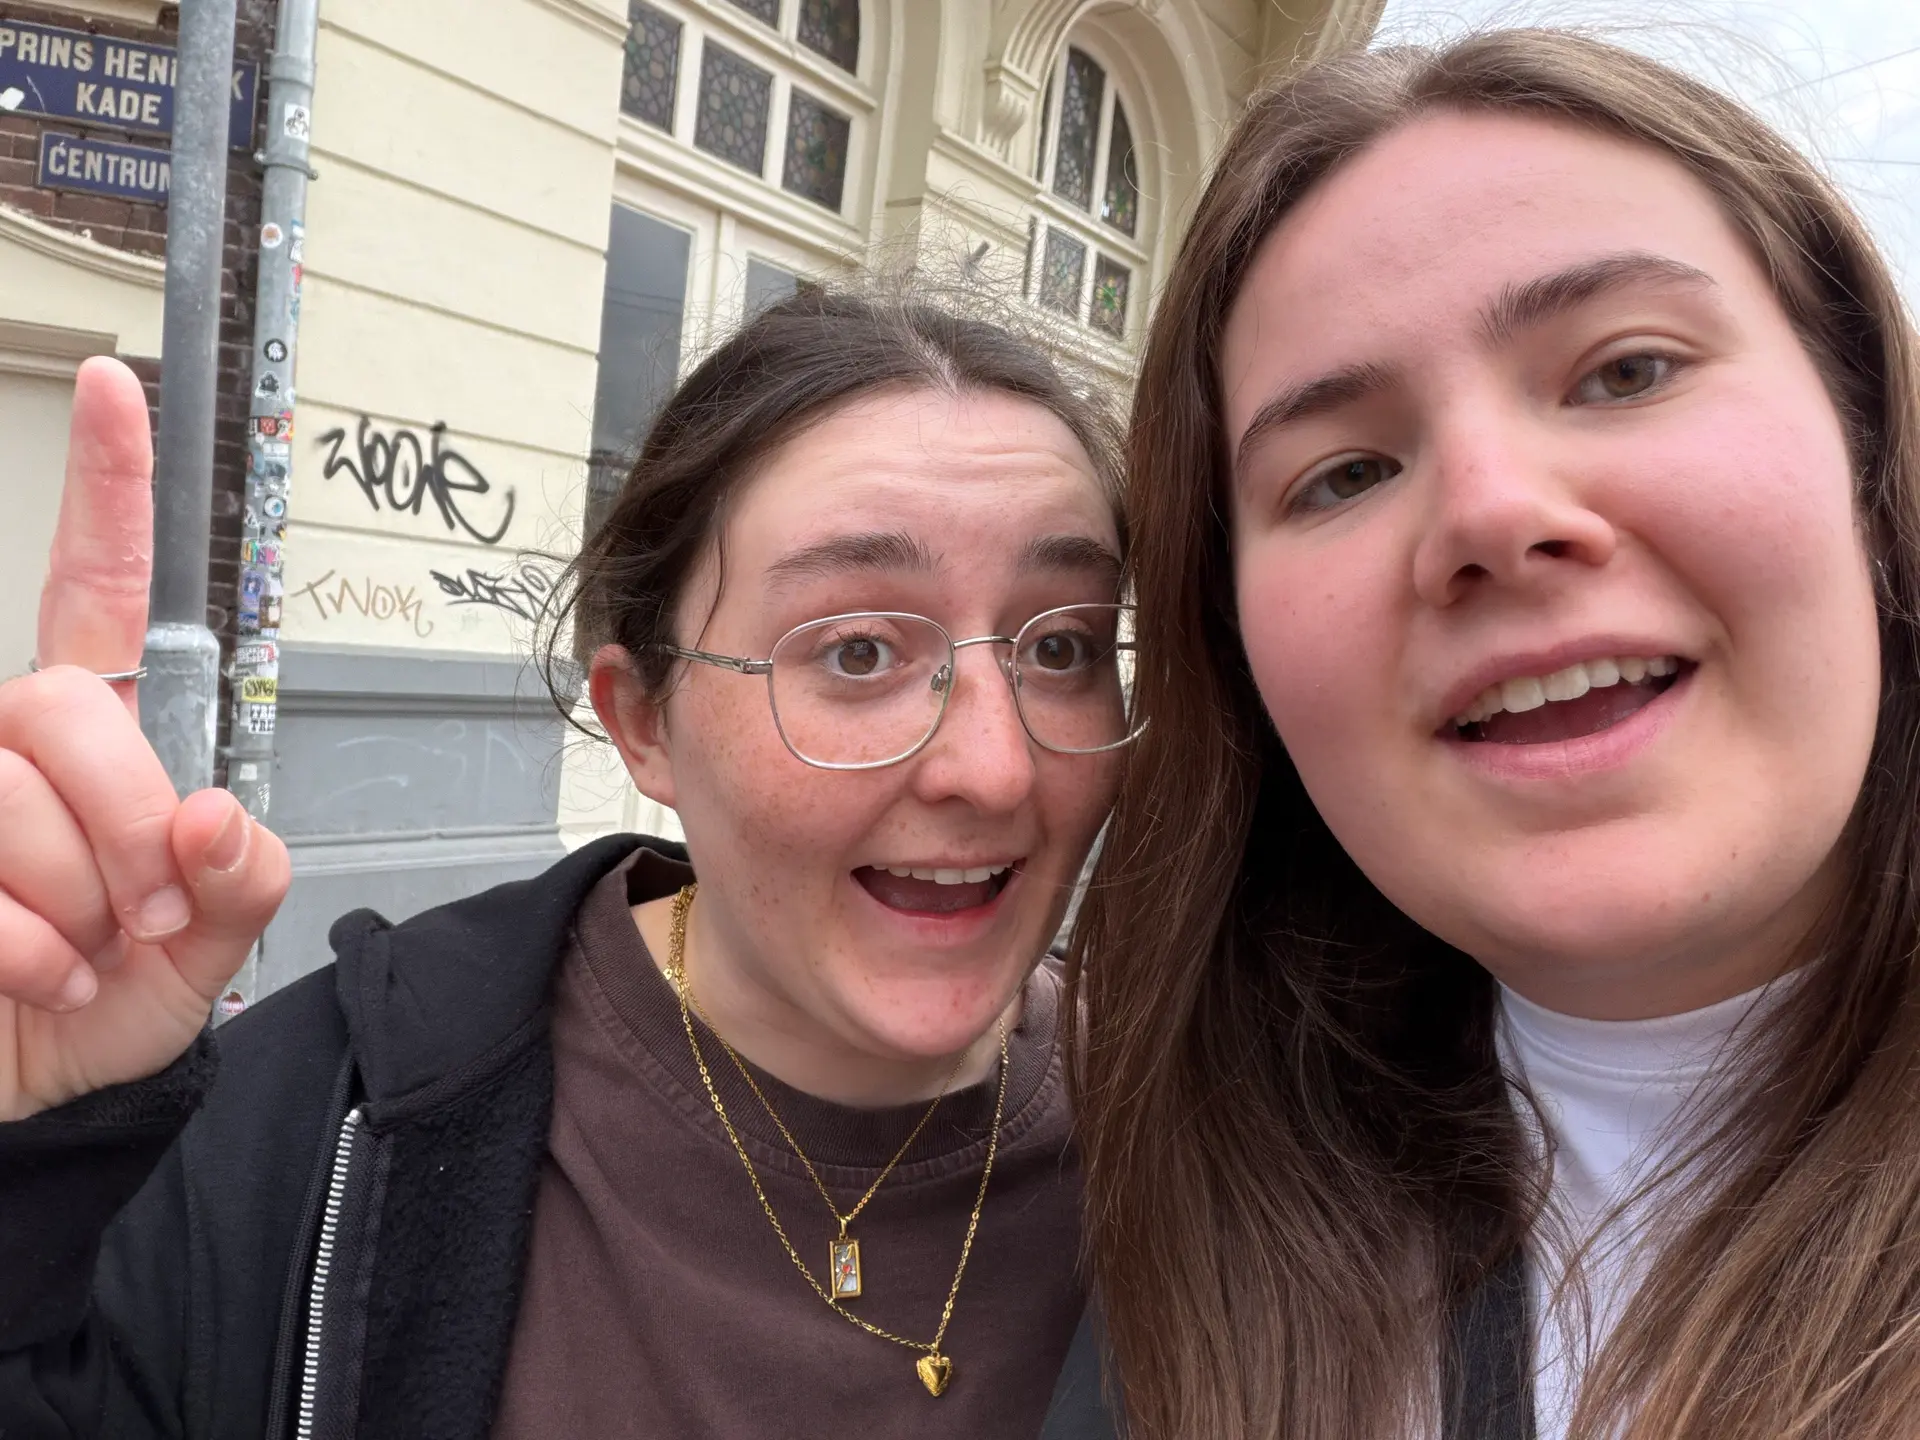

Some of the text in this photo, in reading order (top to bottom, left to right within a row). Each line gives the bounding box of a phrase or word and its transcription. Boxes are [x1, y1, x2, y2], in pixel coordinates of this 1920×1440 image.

[0, 27, 245, 101] PRINS HENK
[76, 82, 162, 126] KADE
